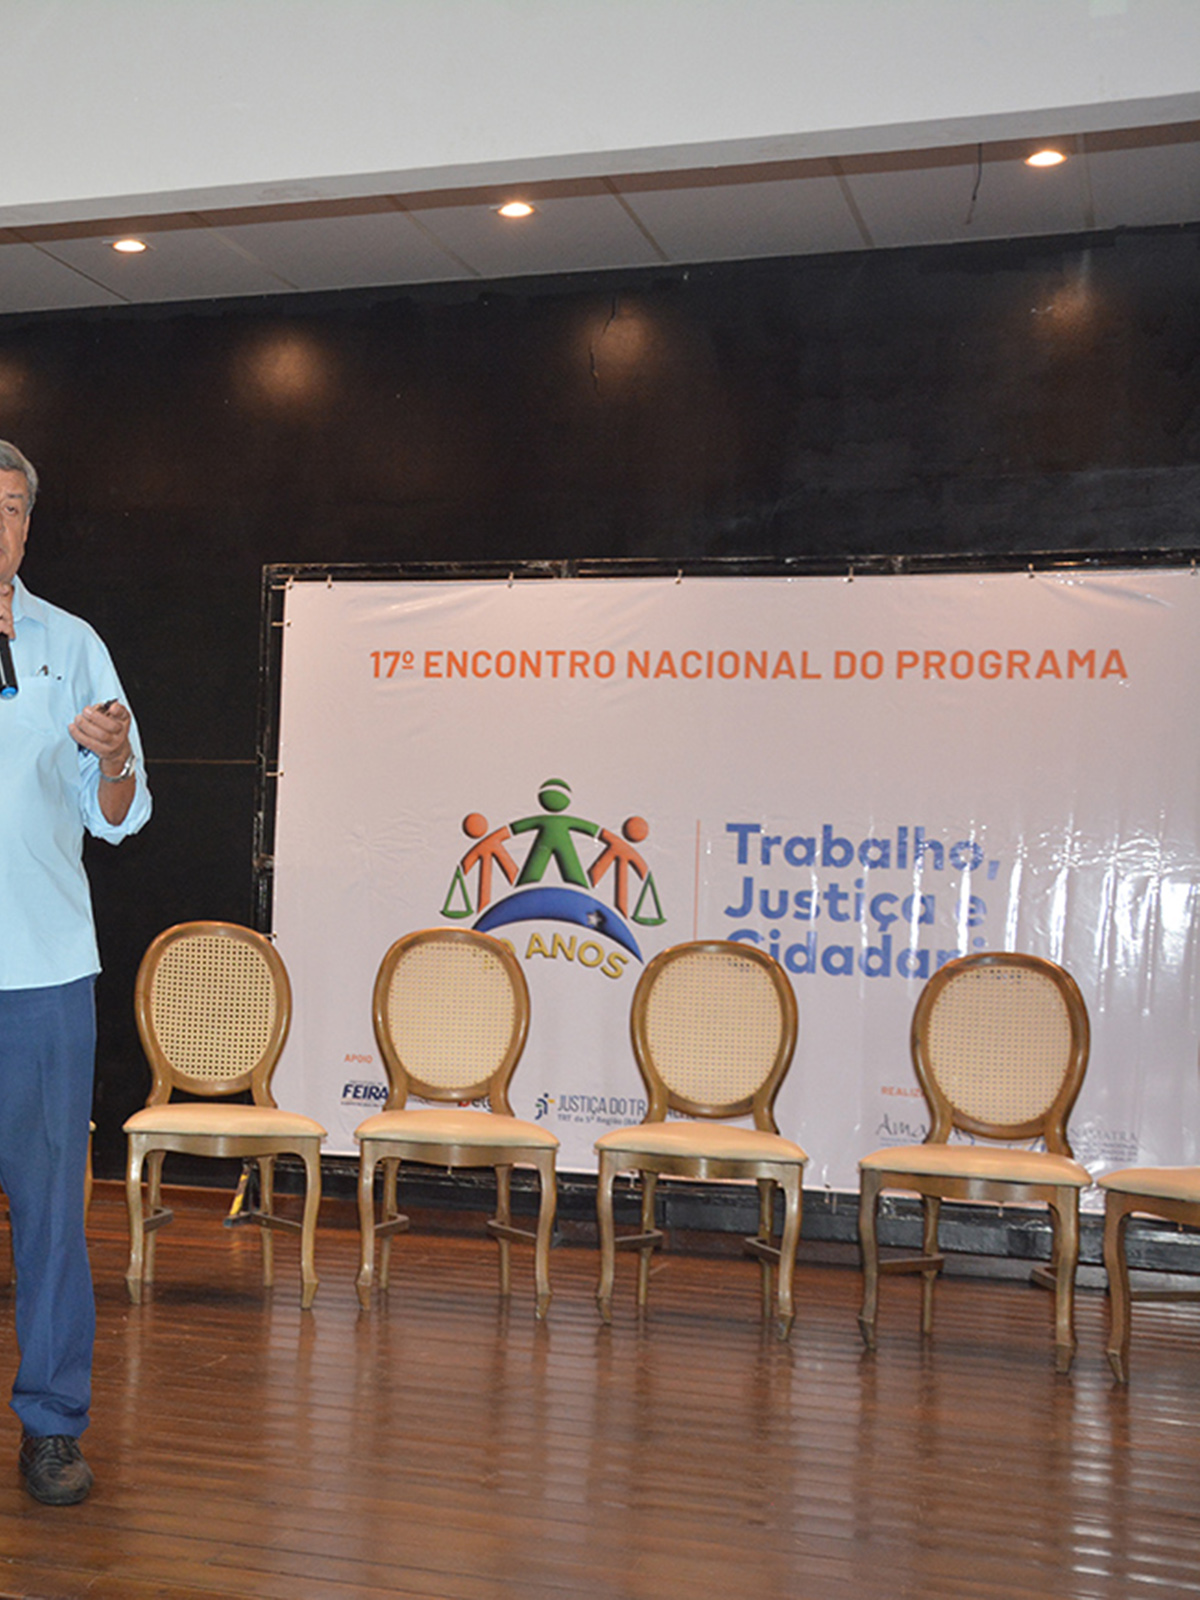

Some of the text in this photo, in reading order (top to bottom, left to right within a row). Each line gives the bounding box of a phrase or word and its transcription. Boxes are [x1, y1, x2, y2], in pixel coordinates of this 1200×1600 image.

[423, 649, 617, 680] ENCONTRO
[625, 649, 822, 681] NACIONAL
[833, 649, 885, 681] DO
[895, 648, 1130, 681] PROGRAMA
[725, 822, 1001, 881] Trabalho,
[723, 875, 988, 933] Justiça e
[525, 932, 629, 980] ANOS
[343, 1053, 374, 1065] APOIO
[341, 1082, 389, 1101] FEIRA
